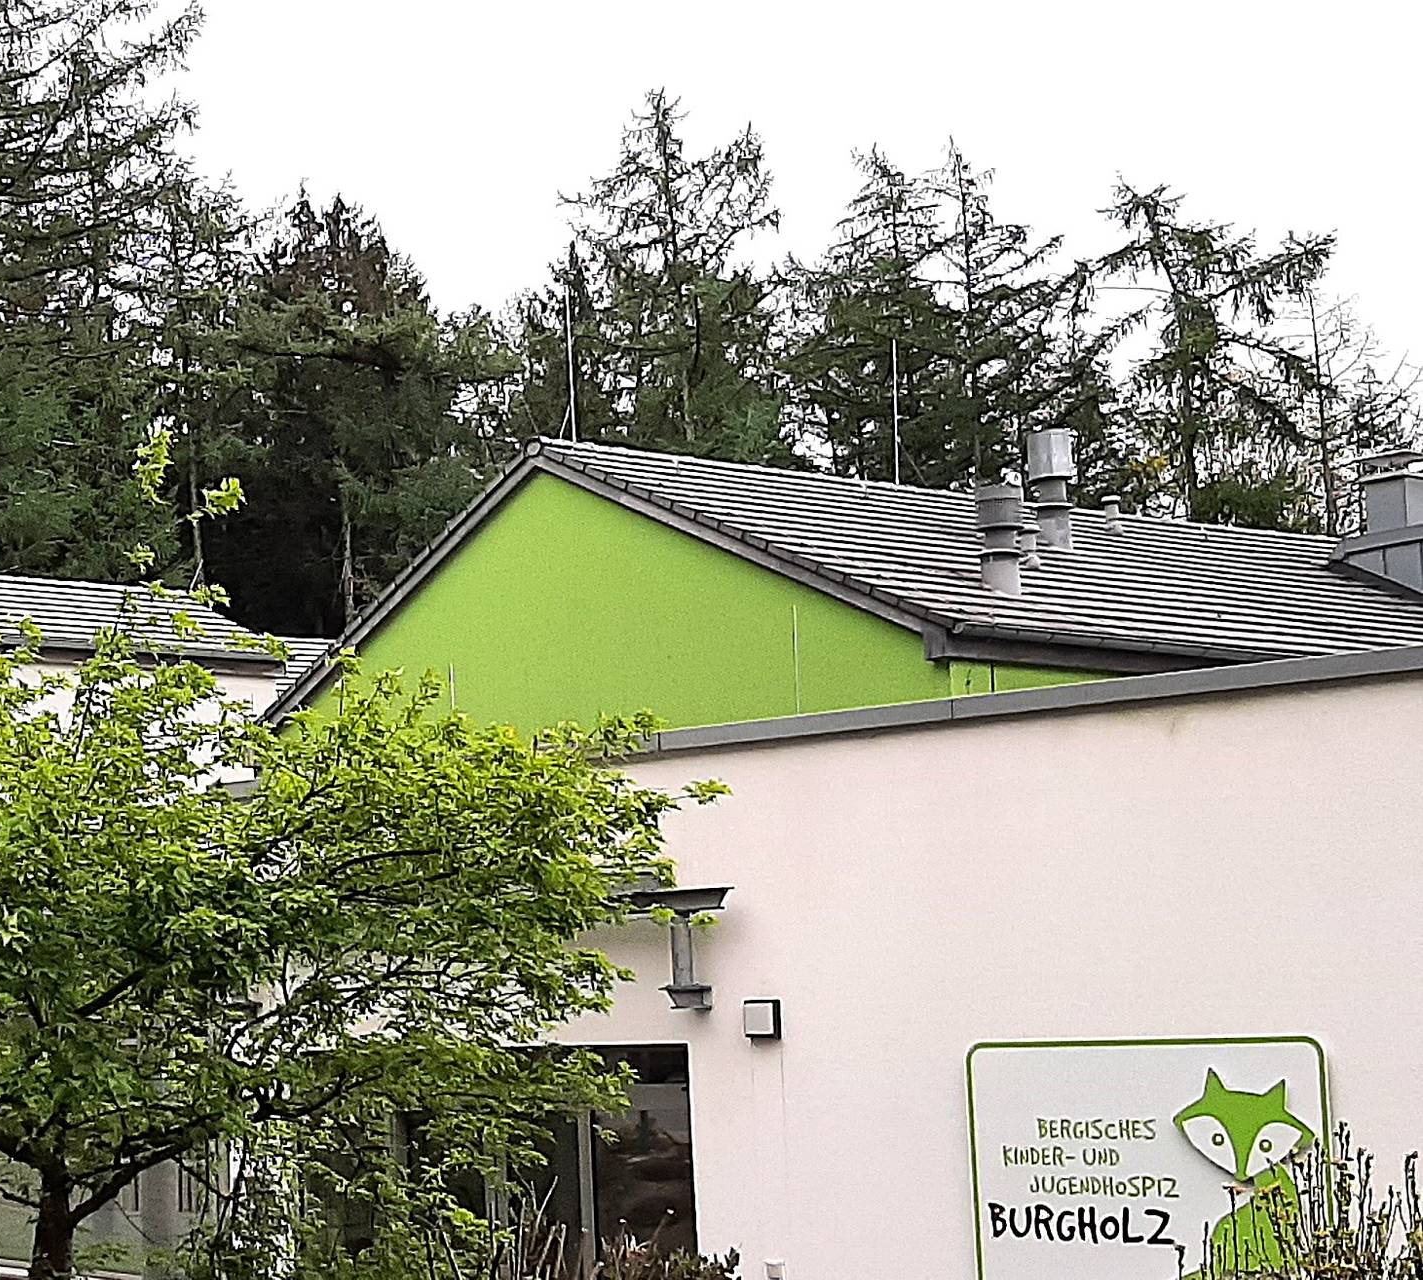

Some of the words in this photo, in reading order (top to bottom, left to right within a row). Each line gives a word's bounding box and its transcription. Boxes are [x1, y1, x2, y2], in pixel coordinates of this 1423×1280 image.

[1036, 1117, 1157, 1140] BERGISCHES
[1002, 1145, 1076, 1167] KINDER-
[1082, 1146, 1120, 1167] UND
[1029, 1175, 1180, 1199] JUGENDHOSPIZ
[988, 1201, 1176, 1245] BURGHOLZ
